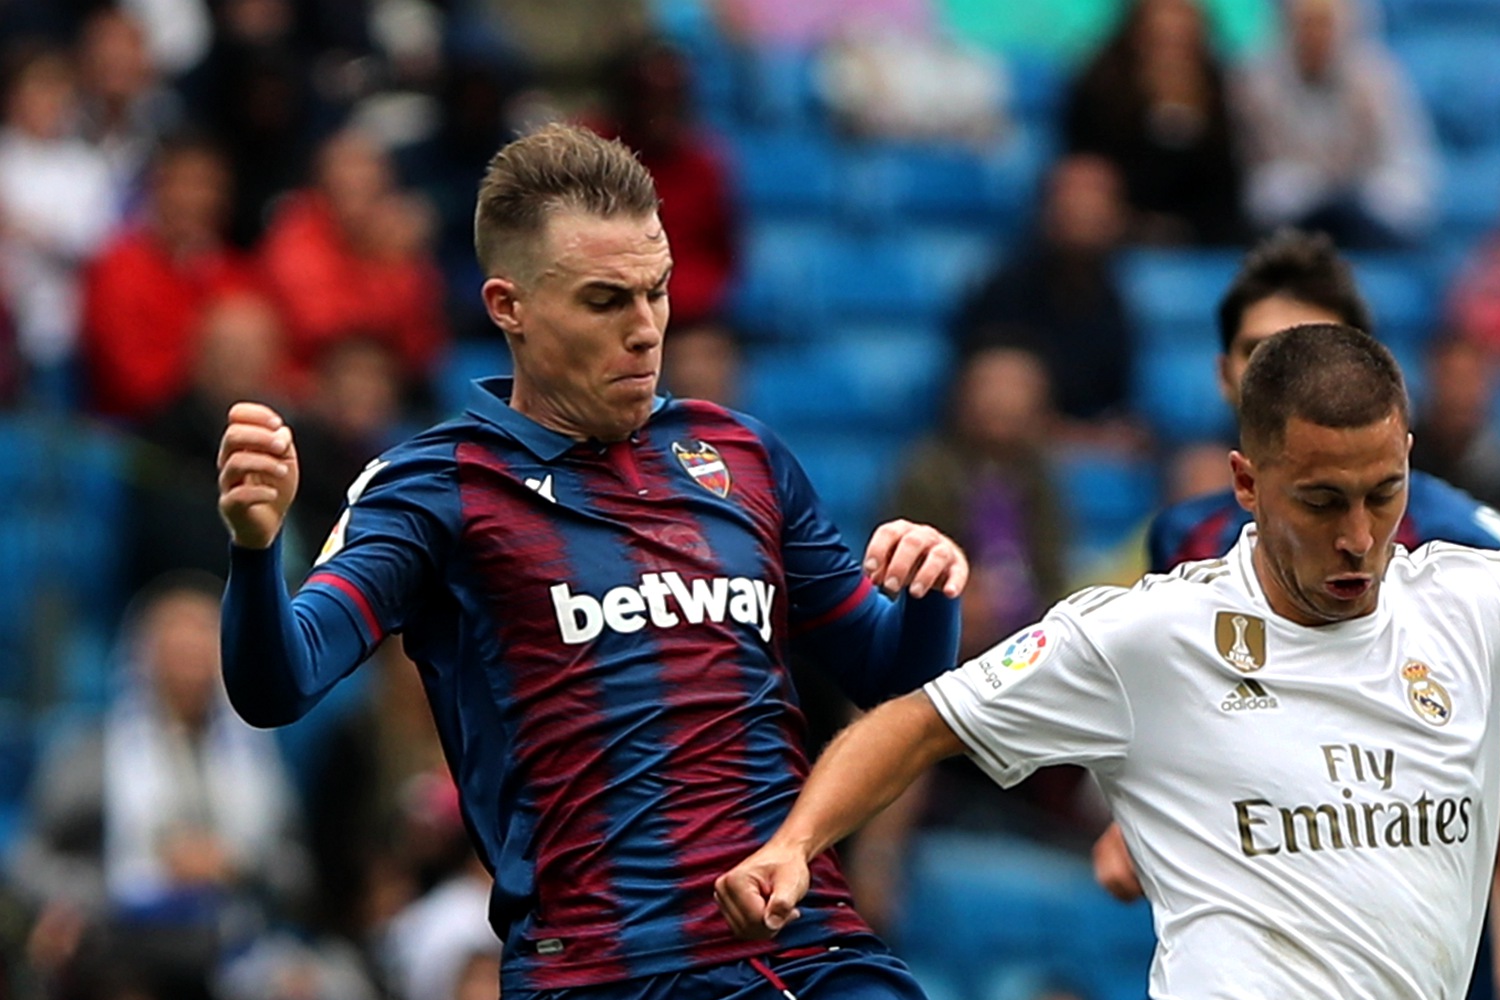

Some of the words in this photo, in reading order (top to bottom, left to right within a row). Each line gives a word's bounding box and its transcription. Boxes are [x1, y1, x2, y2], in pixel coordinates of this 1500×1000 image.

[550, 571, 775, 644] betway
[1221, 697, 1278, 711] adidas
[1320, 743, 1395, 791] Fly
[1233, 788, 1472, 857] Emirates
